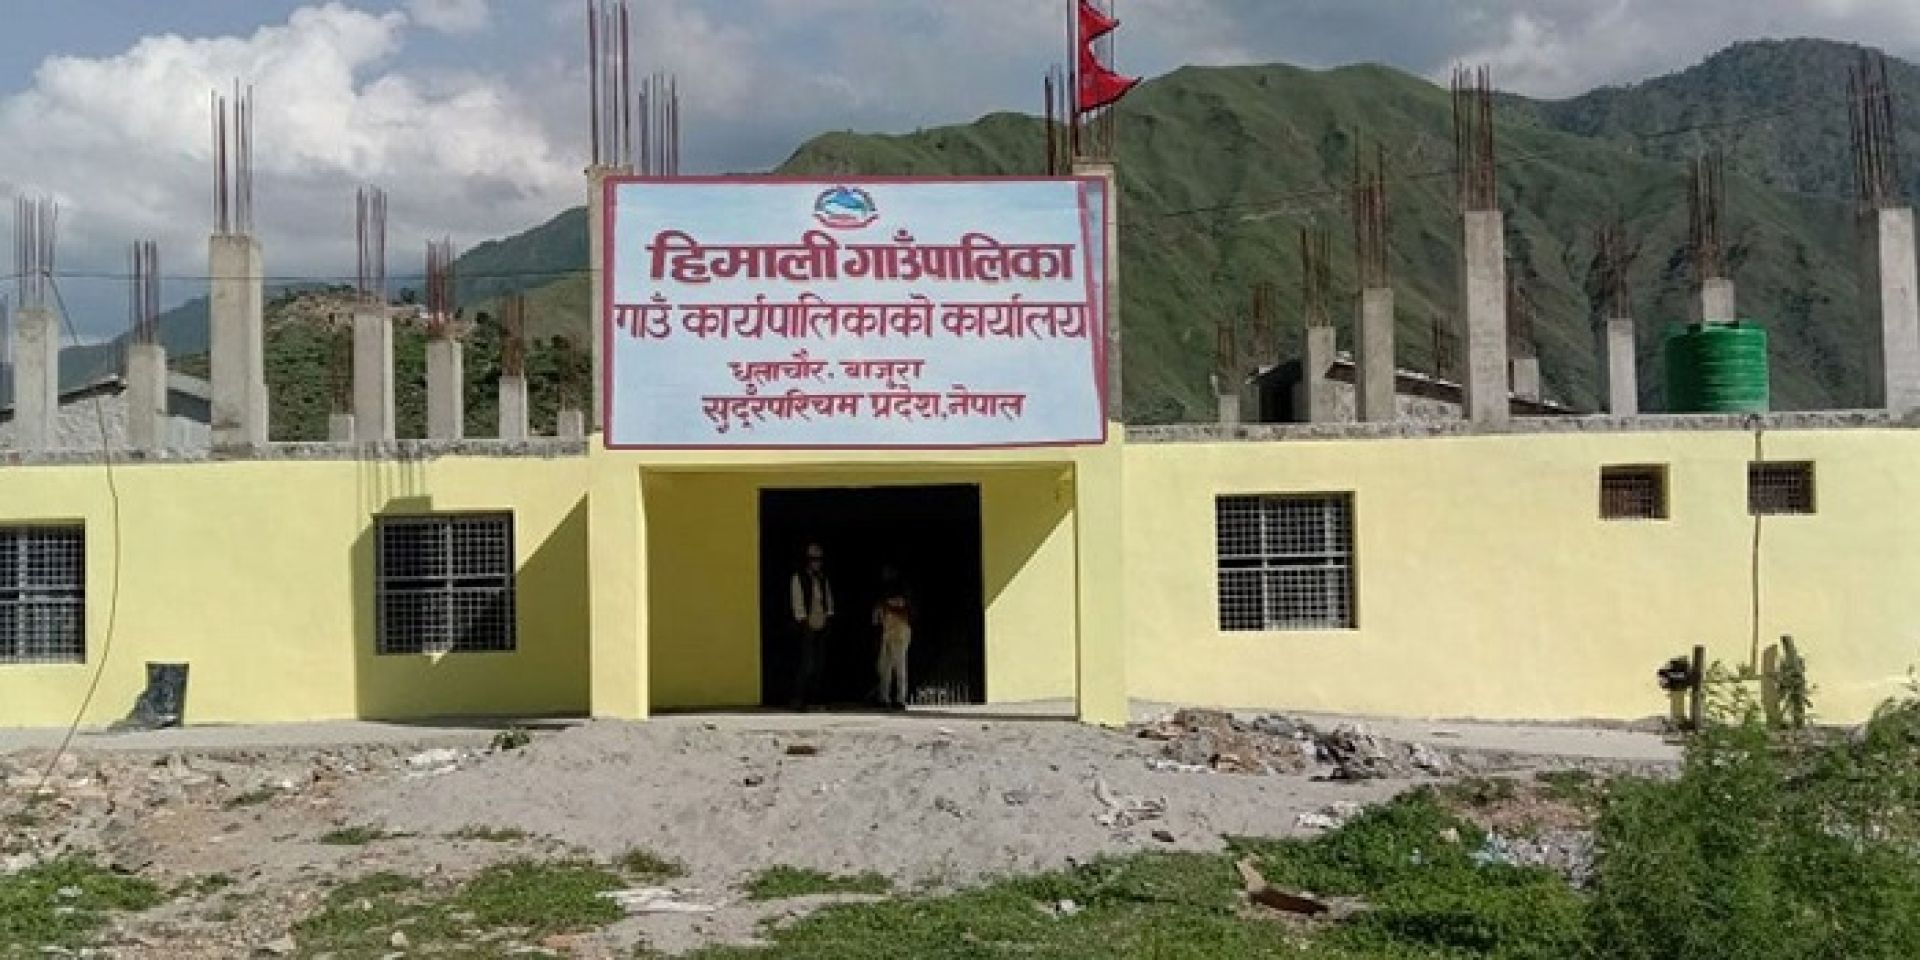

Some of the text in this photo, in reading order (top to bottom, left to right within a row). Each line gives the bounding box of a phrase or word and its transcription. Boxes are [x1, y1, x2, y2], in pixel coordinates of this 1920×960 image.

[647, 229, 1075, 283] हिमाली गाउँपालिका
[614, 291, 1087, 339] गाउँ कार्यपालिकाको कार्यालय
